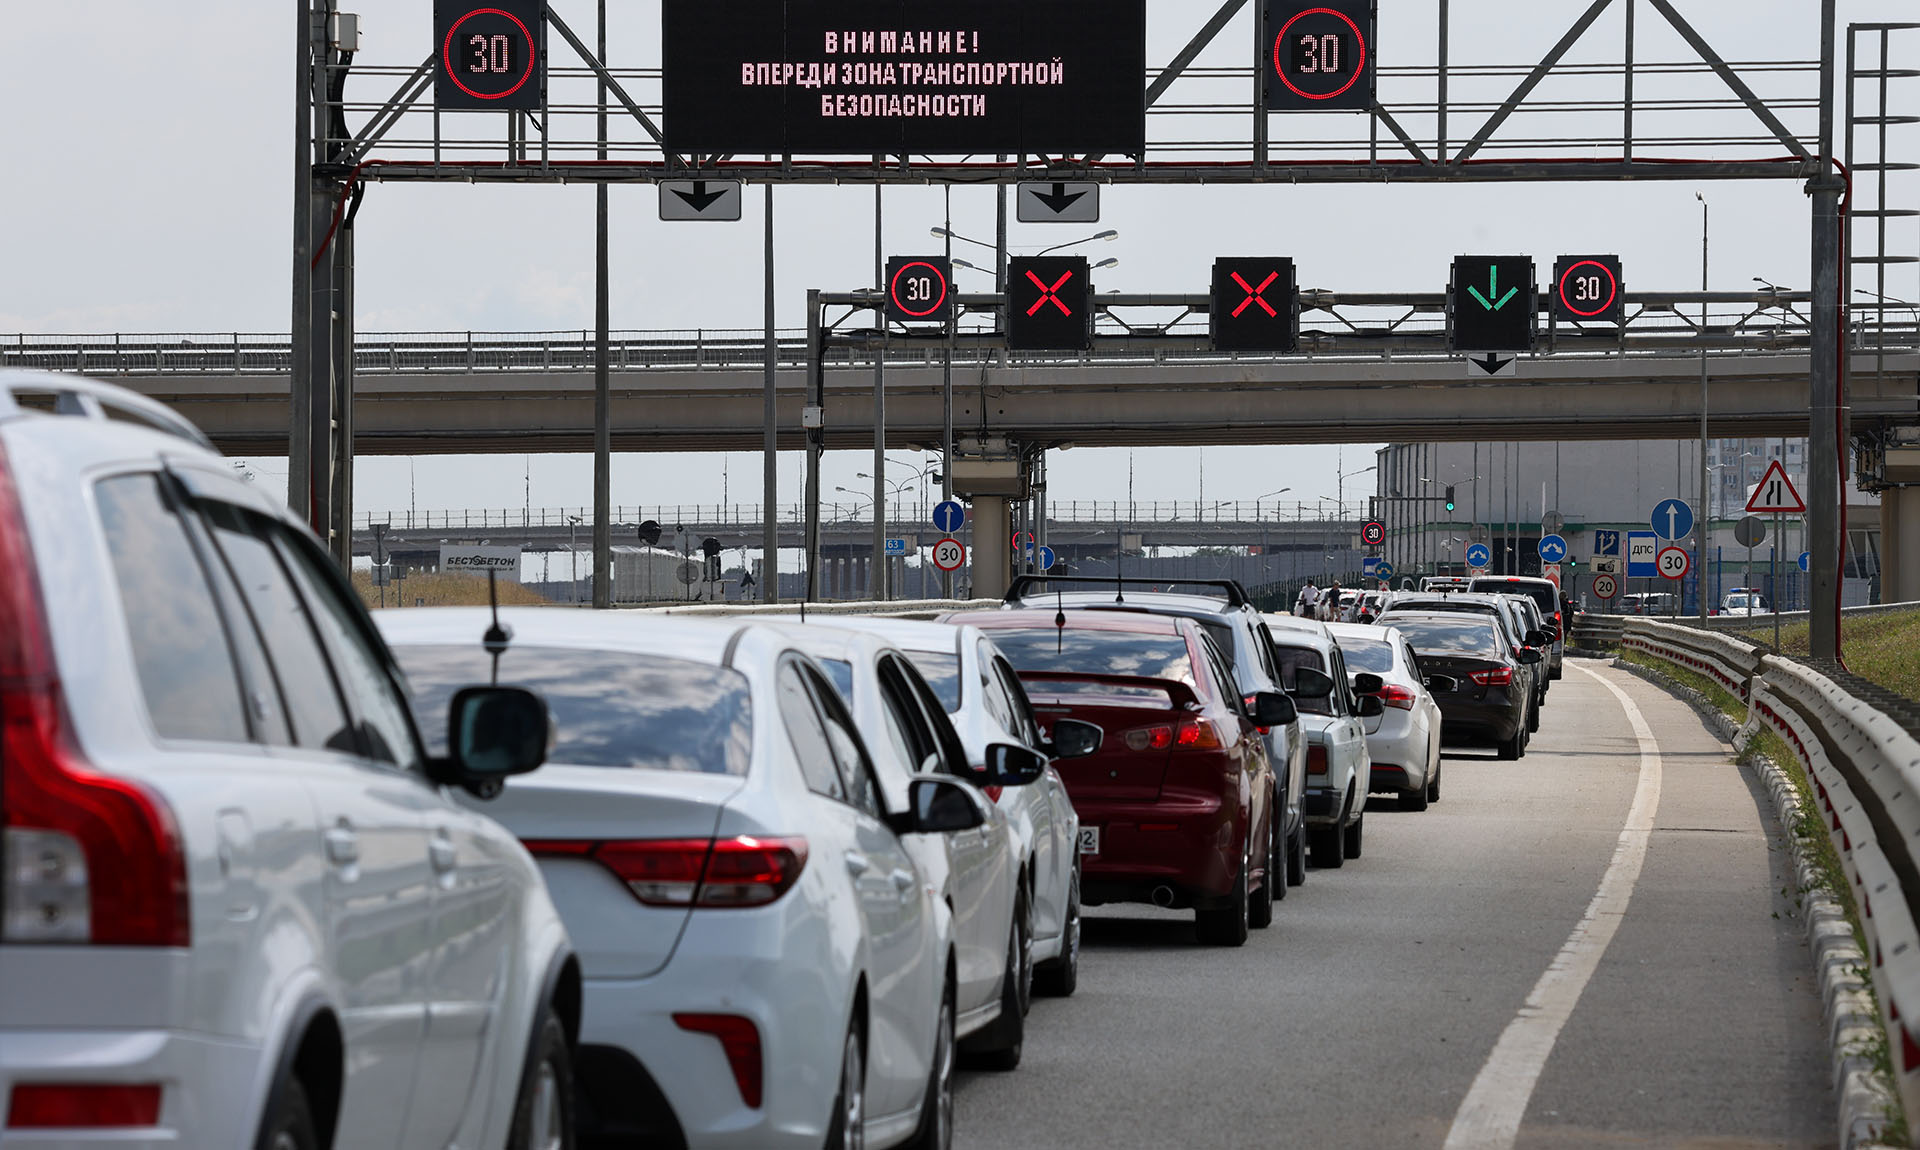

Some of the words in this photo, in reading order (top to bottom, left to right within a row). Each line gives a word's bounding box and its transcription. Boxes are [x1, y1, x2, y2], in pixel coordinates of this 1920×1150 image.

[470, 34, 508, 73] 30
[825, 31, 978, 54] ВНИМАНИЕ!
[1300, 34, 1338, 73] 30
[742, 63, 835, 88] ВПЕРЕДИ
[842, 62, 895, 84] ЗОНА
[899, 57, 1063, 84] ТРАНСПОРТНОЙ
[821, 94, 985, 117] БЕЗОПАСНОСТИ
[907, 277, 930, 300] 30
[1575, 276, 1599, 300] 30
[1368, 528, 1379, 539] 30
[480, 557, 515, 566] БЕТОН
[940, 547, 959, 562] 30
[1631, 545, 1654, 556] ДПС
[1664, 555, 1684, 570] 30
[1598, 581, 1613, 592] 20
